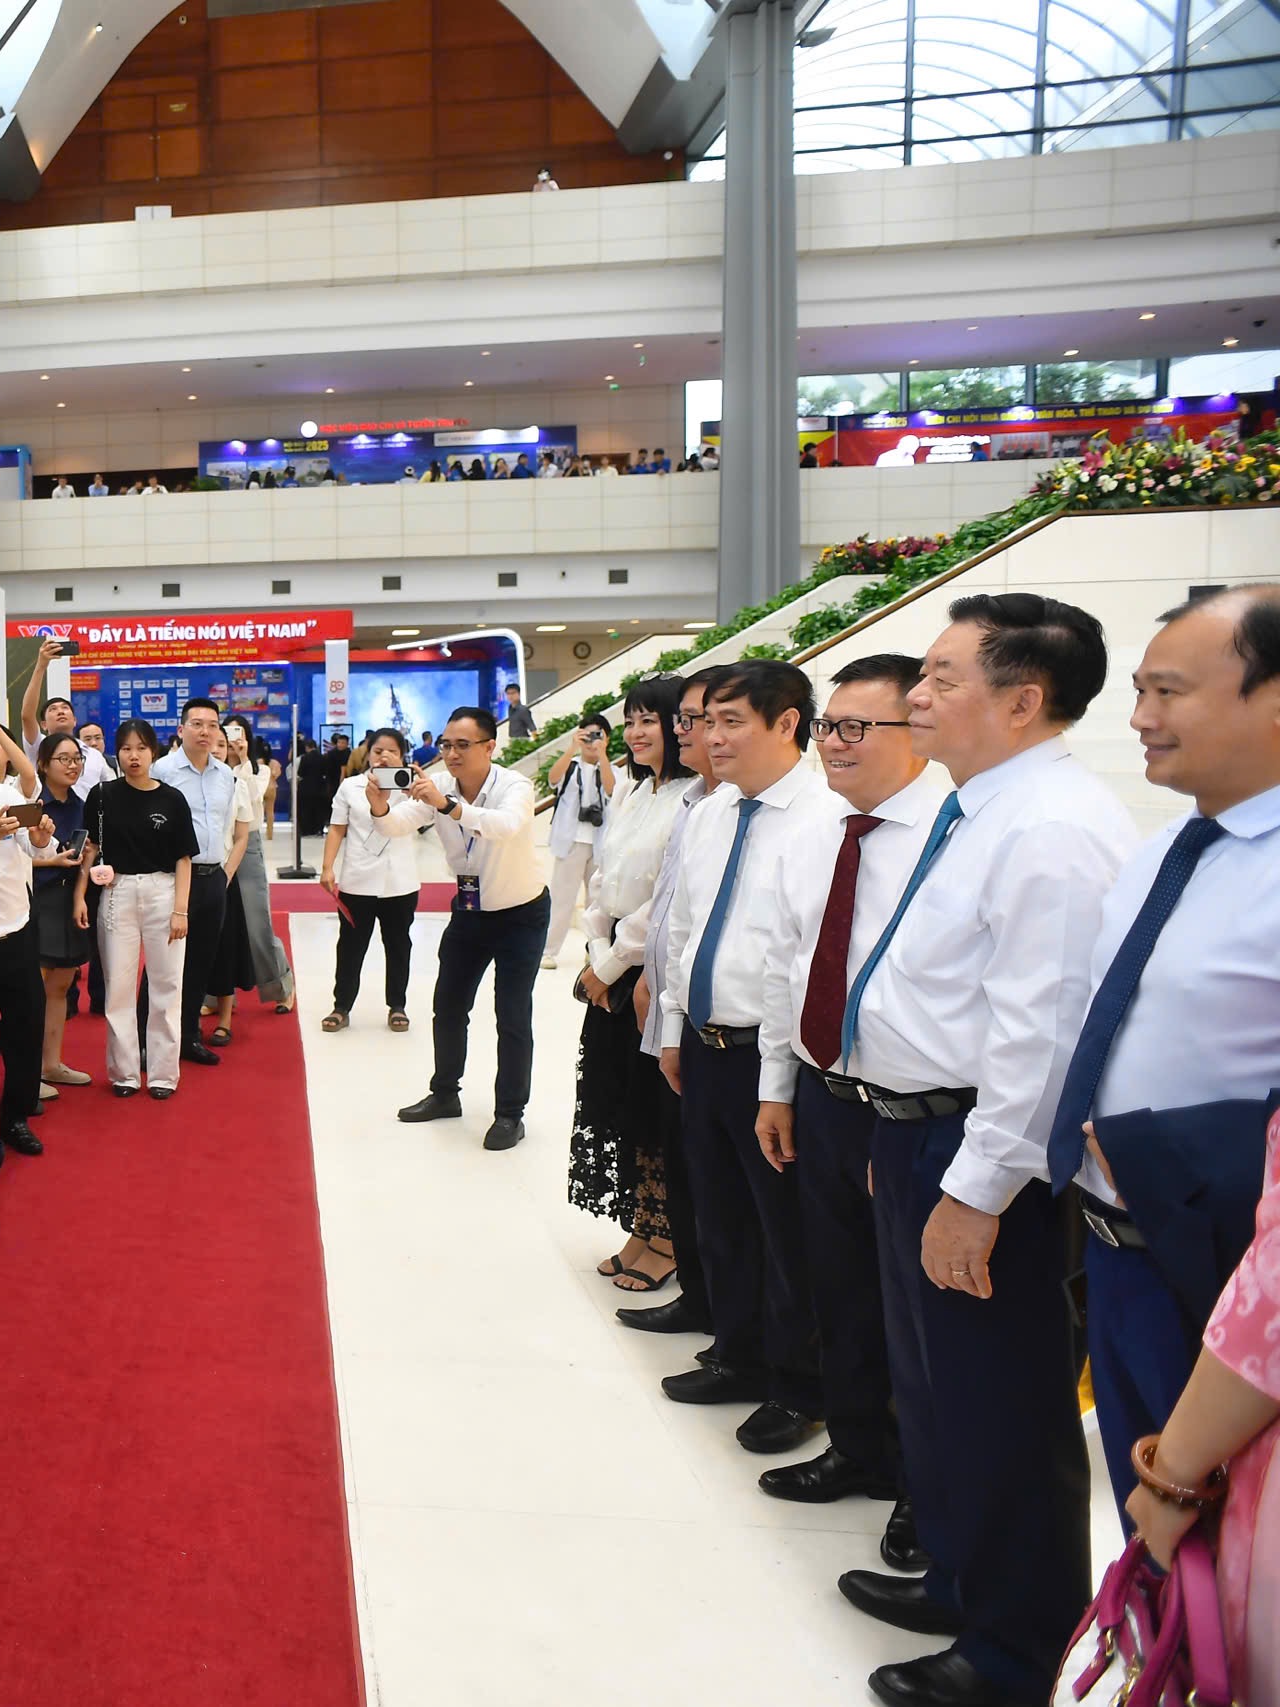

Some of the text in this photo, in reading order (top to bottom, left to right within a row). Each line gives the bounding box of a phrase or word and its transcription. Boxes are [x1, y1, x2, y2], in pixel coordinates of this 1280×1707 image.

[125, 623, 147, 642] LÀ
[148, 619, 196, 642] TIẾNG
[198, 621, 226, 641] NÓI
[228, 620, 267, 642] VIỆT
